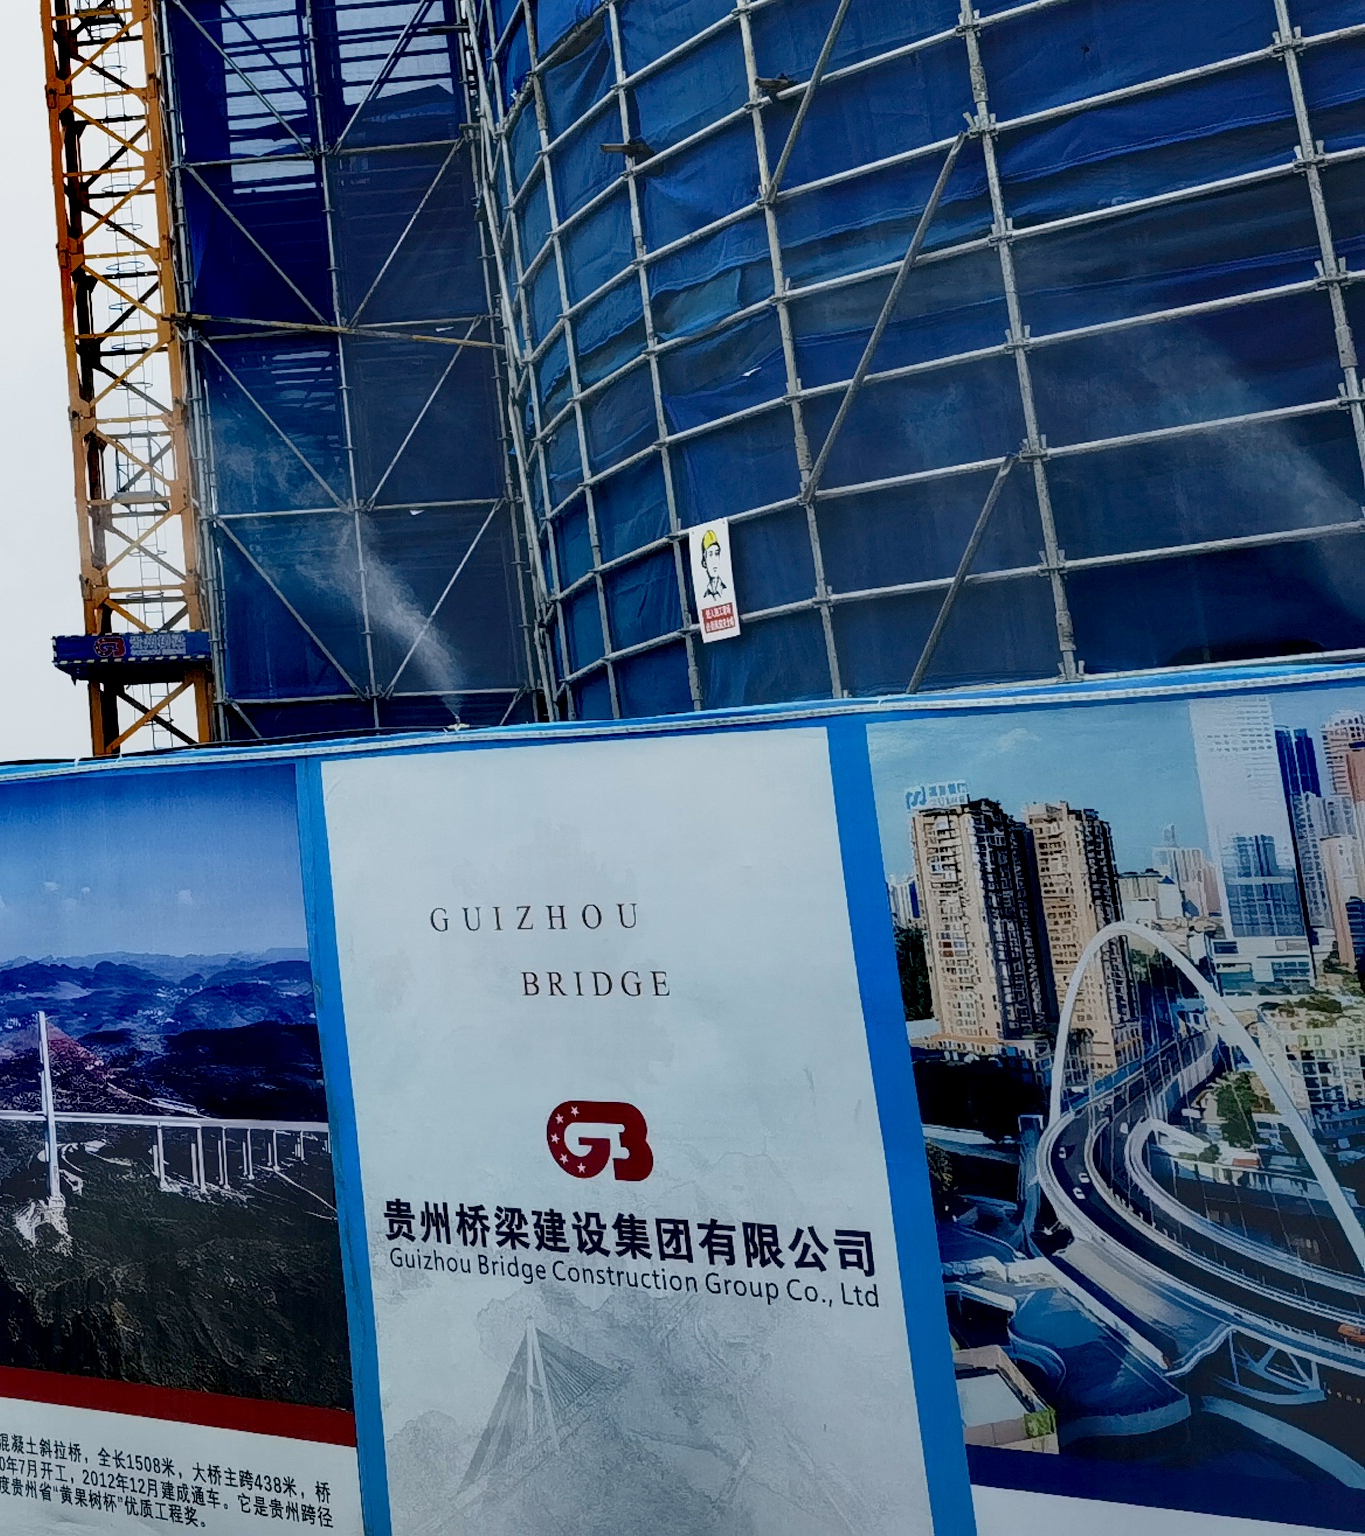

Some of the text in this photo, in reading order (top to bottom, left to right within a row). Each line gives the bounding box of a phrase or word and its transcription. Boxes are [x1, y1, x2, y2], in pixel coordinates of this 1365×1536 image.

[430, 903, 640, 933] GUIZHOU
[522, 970, 671, 998] BRIDGE
[384, 1198, 876, 1277] 贵州桥梁建设集团有限公司
[390, 1247, 880, 1308] Guizhou Bridge Construction Group Co., Ltd
